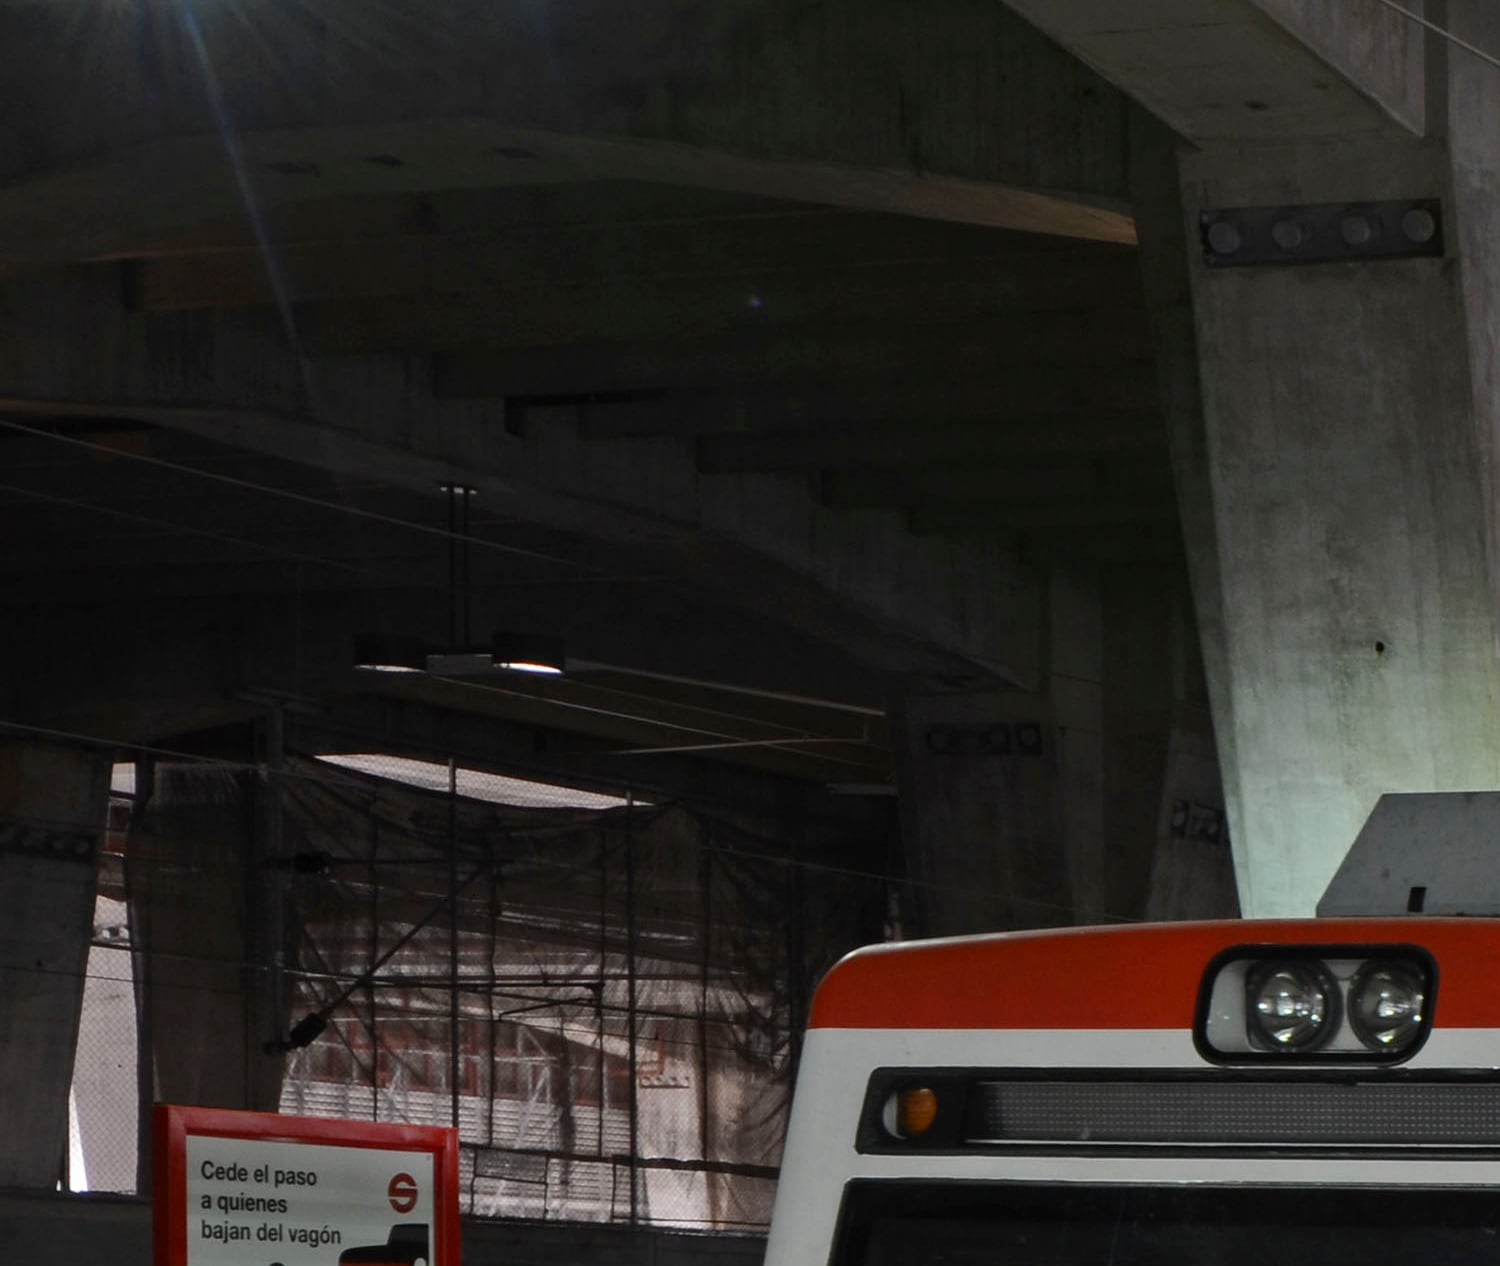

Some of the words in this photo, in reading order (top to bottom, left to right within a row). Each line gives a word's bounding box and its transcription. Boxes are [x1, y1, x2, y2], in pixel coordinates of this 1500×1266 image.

[200, 1160, 248, 1182] Cede
[253, 1164, 268, 1183] el
[274, 1169, 318, 1188] paso
[201, 1194, 211, 1209] a
[217, 1192, 288, 1215] quienes
[201, 1219, 250, 1244] bajan
[256, 1223, 283, 1242] del
[288, 1225, 342, 1248] vagón
